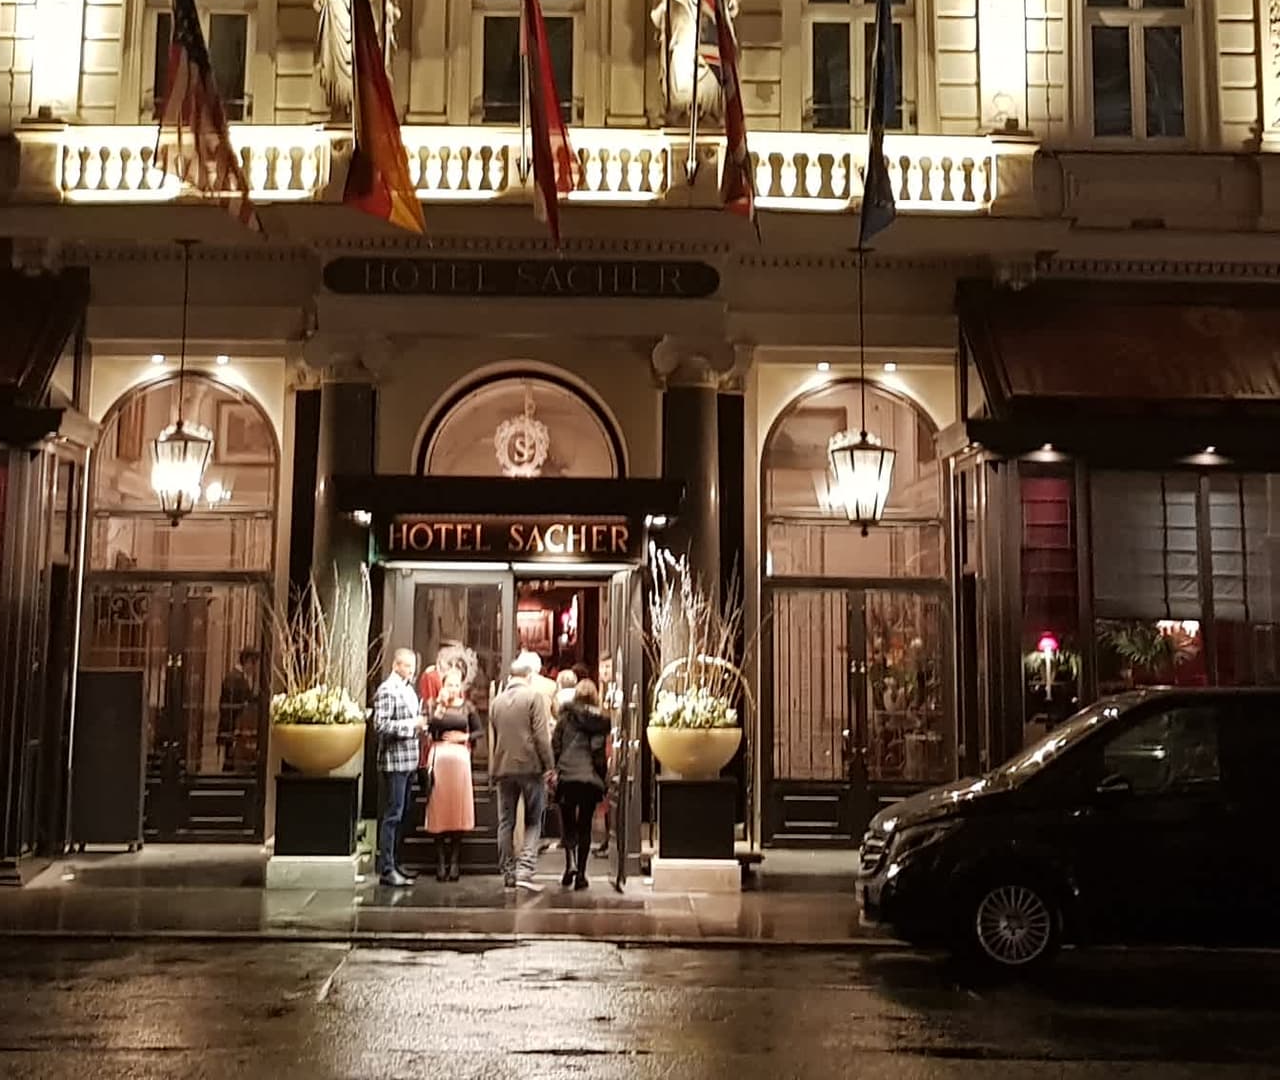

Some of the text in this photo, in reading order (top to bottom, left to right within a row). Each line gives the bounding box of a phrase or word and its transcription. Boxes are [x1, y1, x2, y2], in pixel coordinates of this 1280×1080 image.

[364, 262, 684, 294] HOTEL SACHER
[388, 522, 629, 552] HOTEL SACHER
